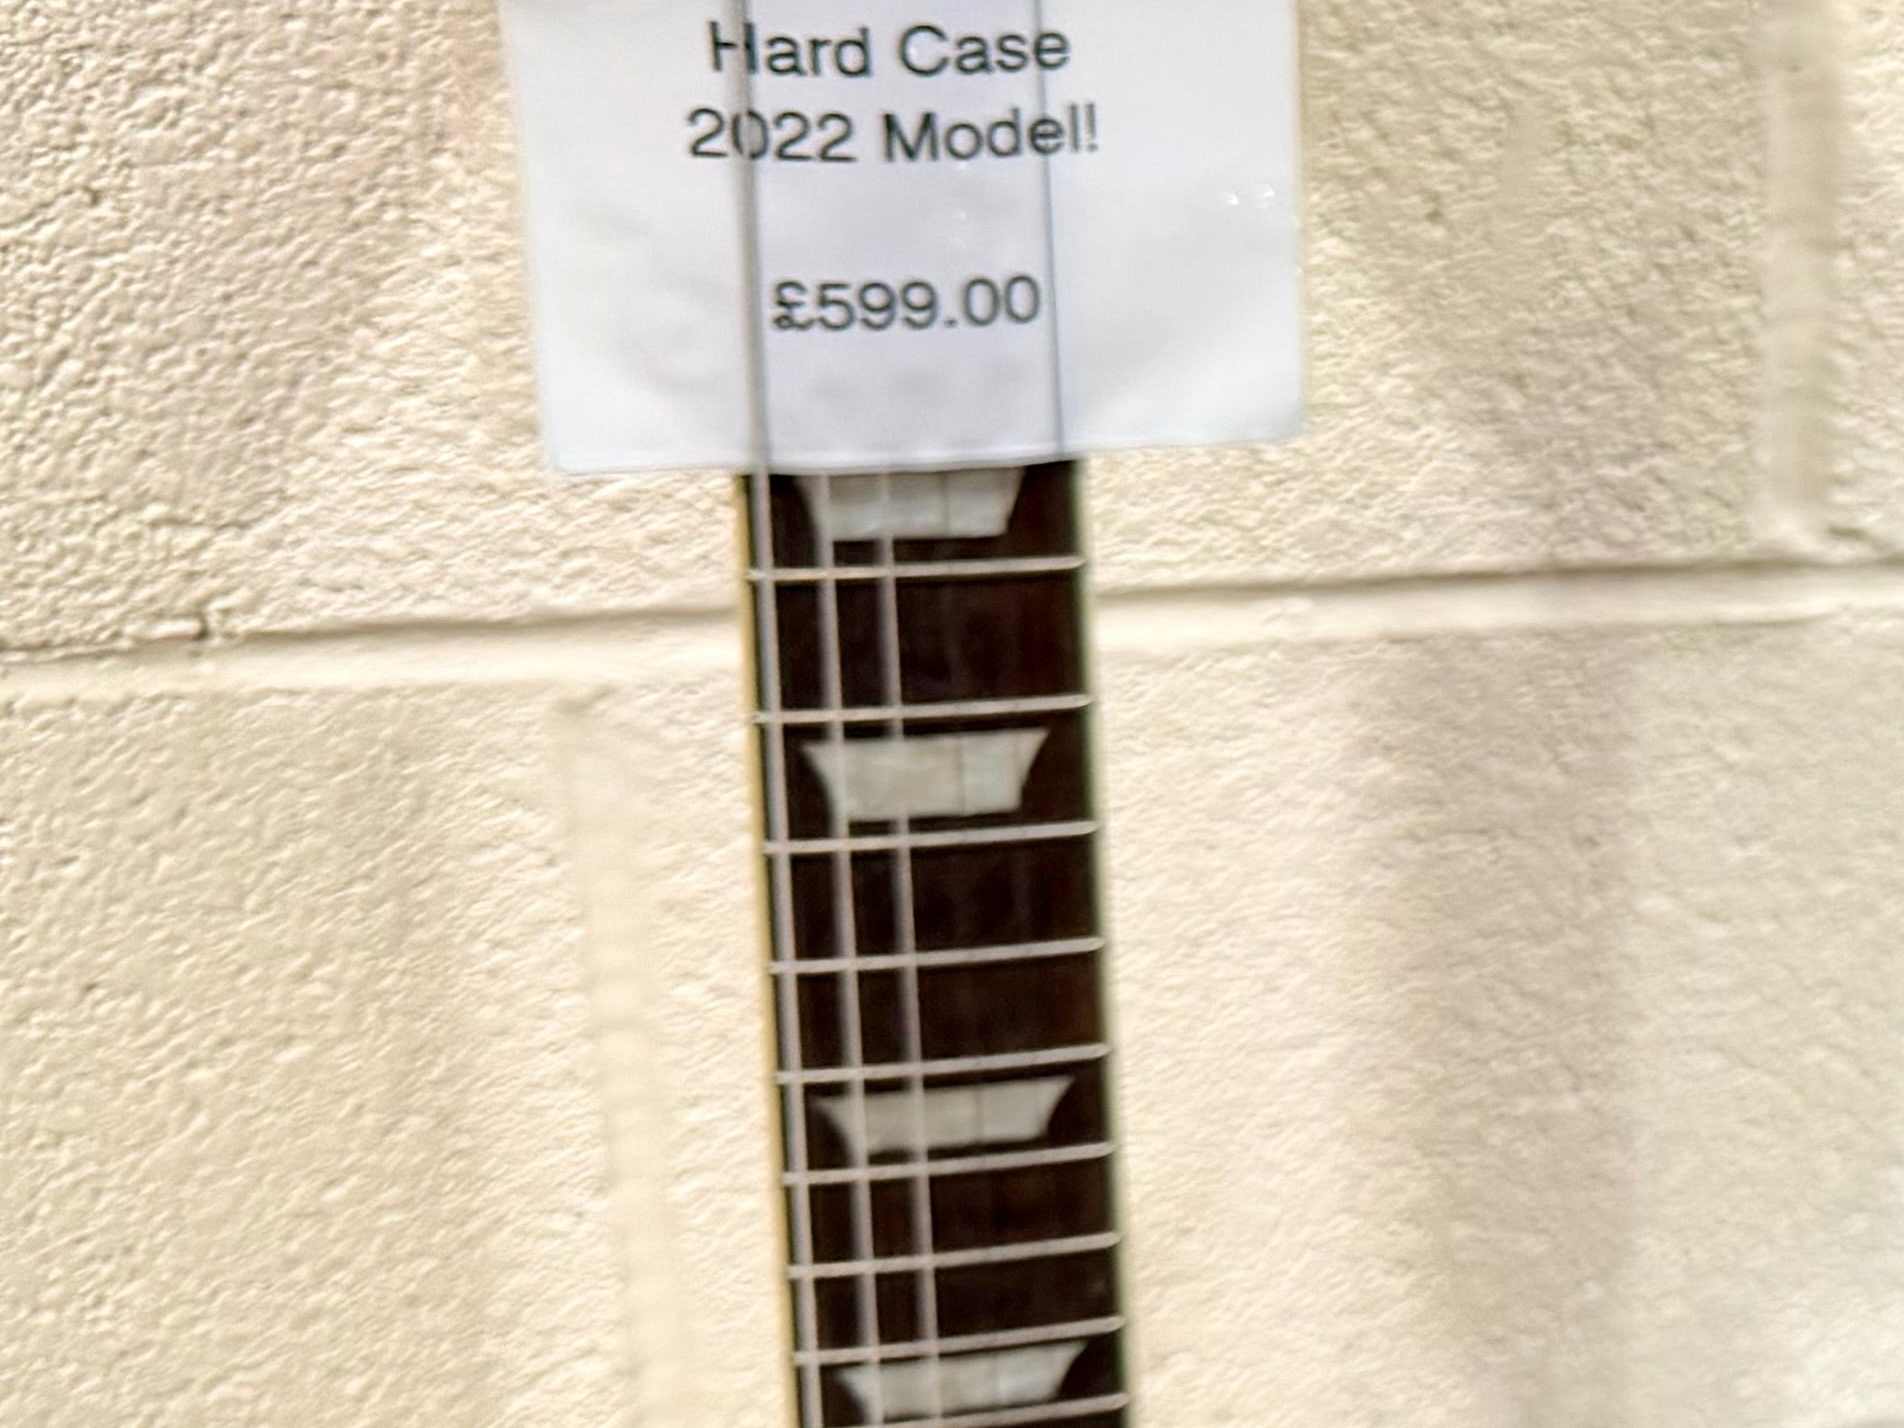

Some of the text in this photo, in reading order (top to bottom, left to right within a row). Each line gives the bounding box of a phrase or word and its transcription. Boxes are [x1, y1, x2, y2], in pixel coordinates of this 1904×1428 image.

[709, 22, 1072, 80] Hard Case
[686, 101, 1100, 164] 2022 Model!
[773, 274, 1043, 333] £599.00
